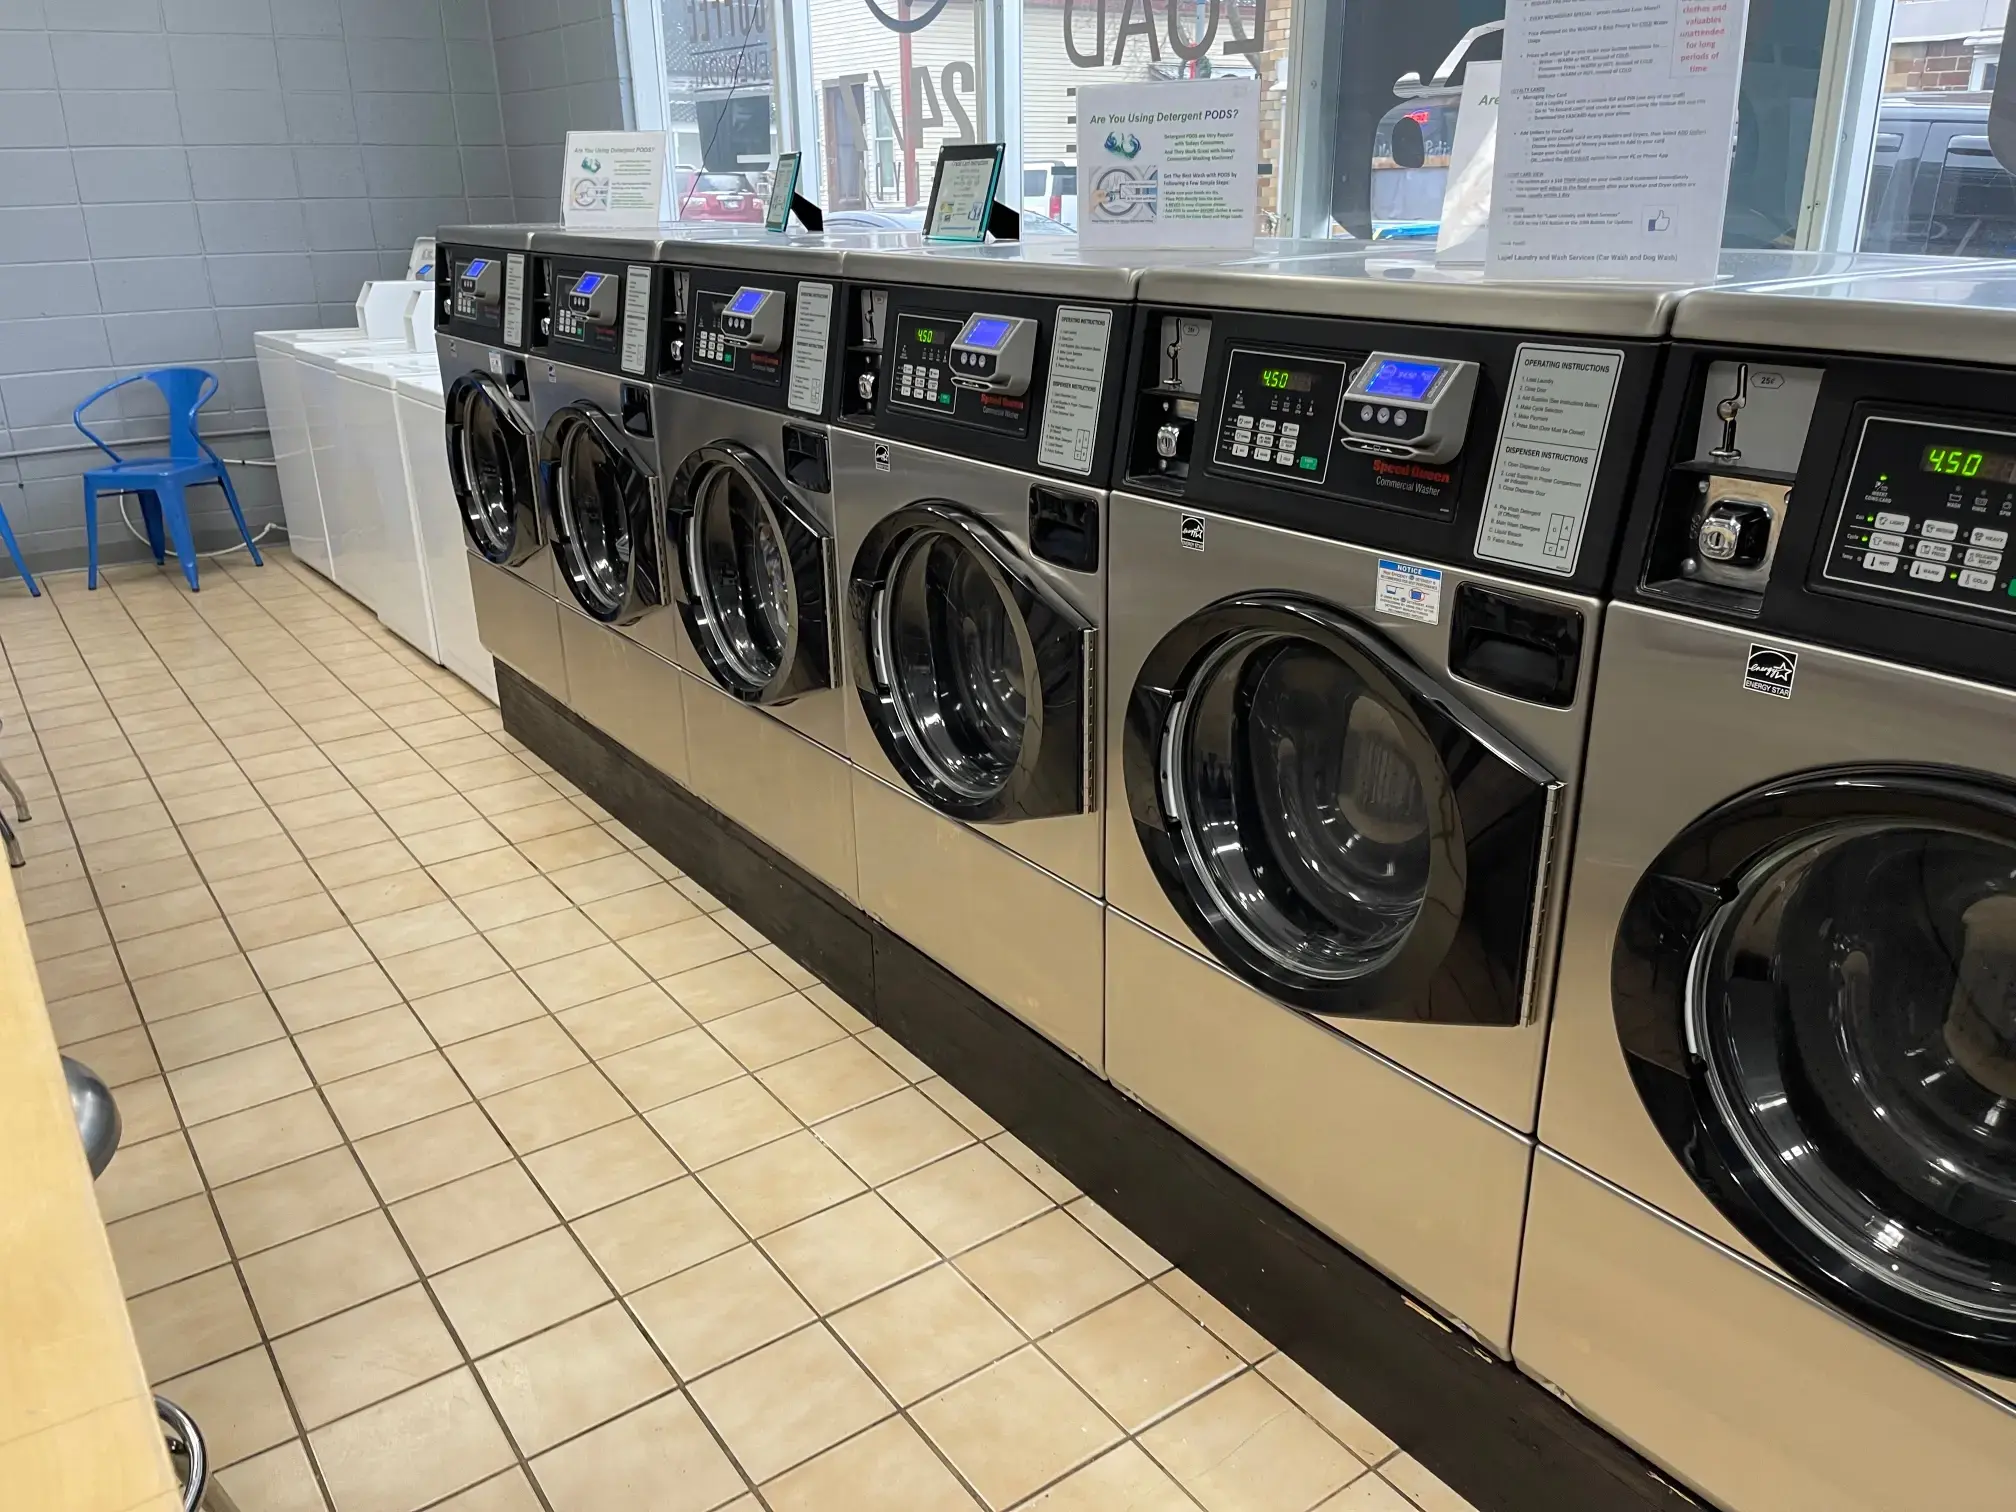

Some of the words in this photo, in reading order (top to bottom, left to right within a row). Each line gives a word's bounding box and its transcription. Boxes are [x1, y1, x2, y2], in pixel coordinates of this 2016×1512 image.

[1683, 4, 1710, 13] clothes
[1712, 2, 1727, 12] and
[1686, 17, 1721, 25] valuables
[1680, 28, 1724, 37] unattended
[1681, 53, 1709, 63] periods
[1090, 115, 1106, 124] Are
[1109, 114, 1125, 123] You
[1128, 113, 1154, 124] Using
[1157, 111, 1202, 123] Detergent
[1205, 109, 1239, 120] PODS?
[1597, 254, 1609, 262] (Car
[1657, 254, 1678, 262] Wash)
[1524, 359, 1560, 369] OPERATING
[1562, 362, 1610, 373] INSTRUCTIONS
[1505, 446, 1540, 457] DISPENSER
[1541, 451, 1589, 464] INSTRUCTIONS
[1928, 448, 1983, 478] 4.50
[1376, 475, 1414, 491] Commercial
[1415, 483, 1440, 496] Washer
[1397, 565, 1422, 575] NOTICE
[1973, 577, 1988, 585] COLD
[1746, 680, 1771, 691] ENERGY
[1772, 687, 1789, 696] STAR
